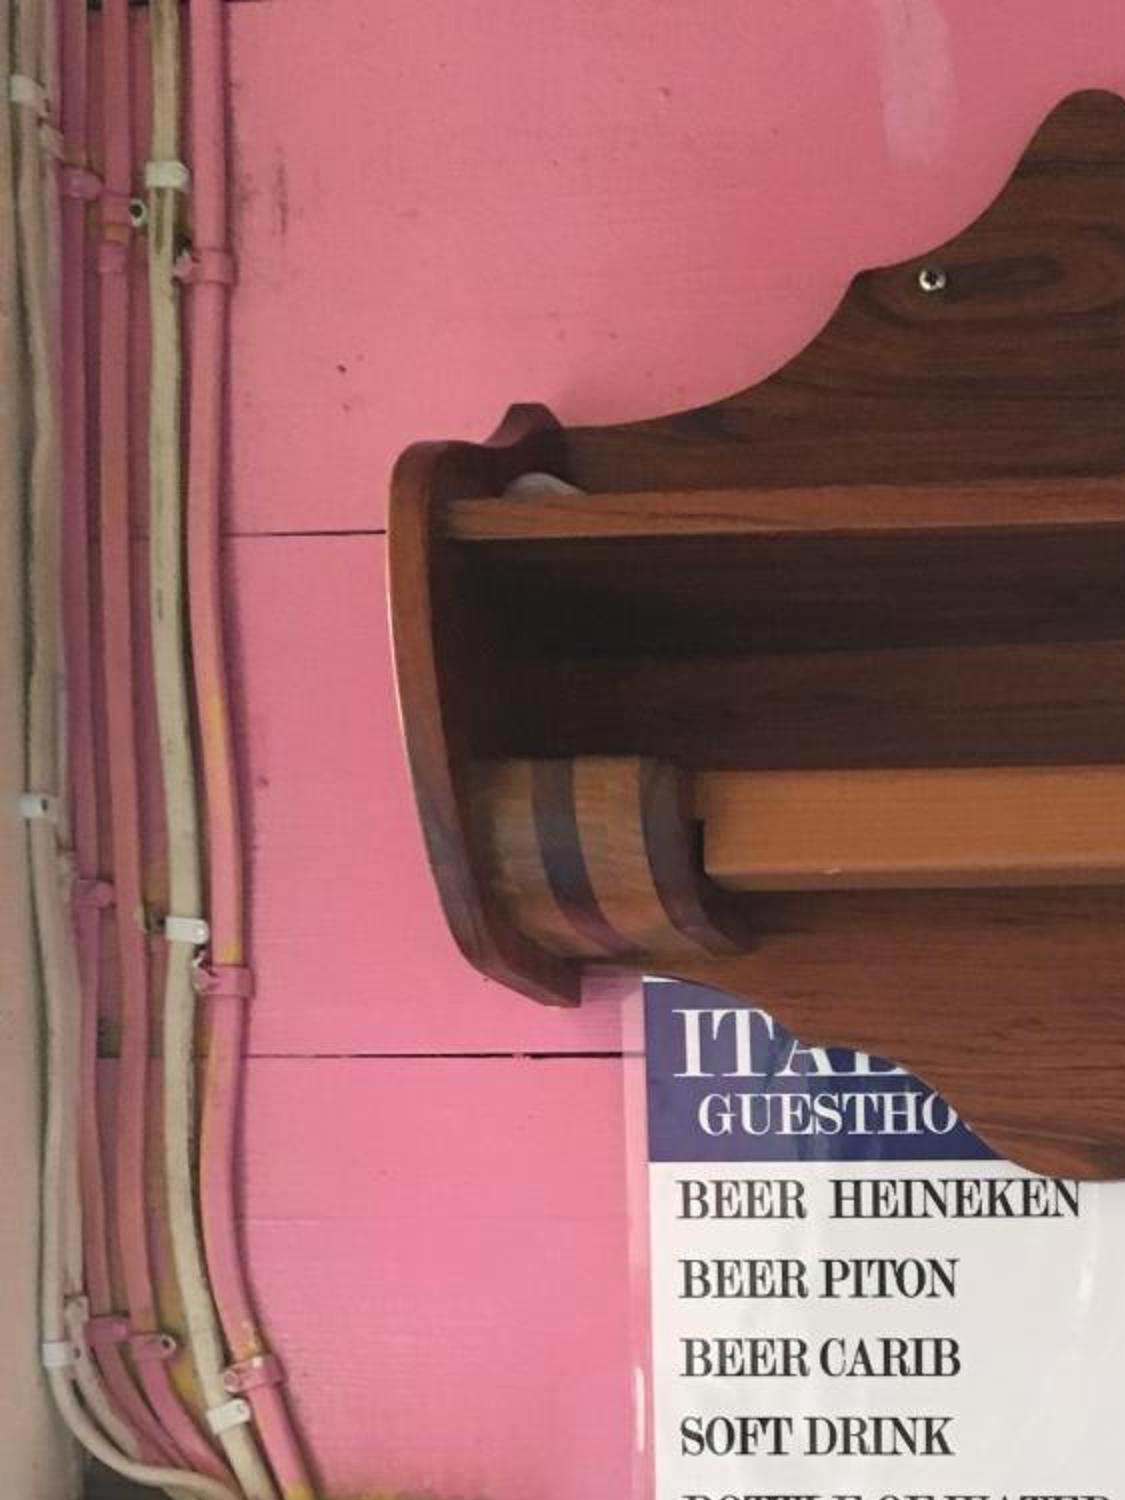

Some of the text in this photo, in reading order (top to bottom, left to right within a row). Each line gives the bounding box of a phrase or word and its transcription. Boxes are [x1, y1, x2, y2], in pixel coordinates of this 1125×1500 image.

[698, 1091, 972, 1136] GUESTHO
[677, 1179, 807, 1220] BEER
[828, 1178, 1082, 1219] HEINEKEN
[678, 1259, 808, 1300] BEER
[819, 1259, 959, 1299] PITON
[679, 1338, 810, 1378] BEER
[819, 1338, 962, 1379] CARIB
[680, 1417, 793, 1458] SOFT
[804, 1418, 954, 1458] DRINK
